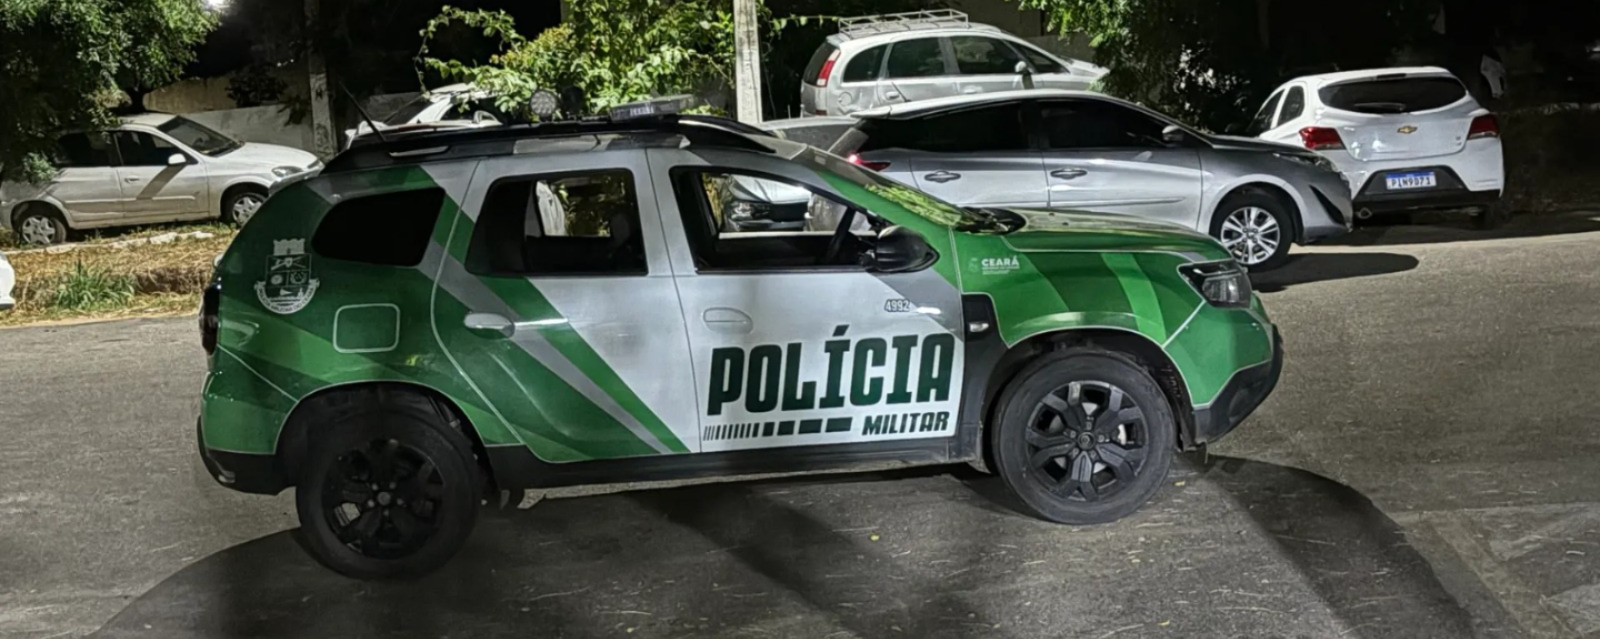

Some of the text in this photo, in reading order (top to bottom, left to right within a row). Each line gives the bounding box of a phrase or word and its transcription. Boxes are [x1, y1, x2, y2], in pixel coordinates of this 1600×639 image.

[981, 255, 1019, 267] CEARÁ
[884, 298, 910, 312] 4992
[707, 324, 955, 416] POLÍCIA
[862, 411, 950, 436] MILITAR
